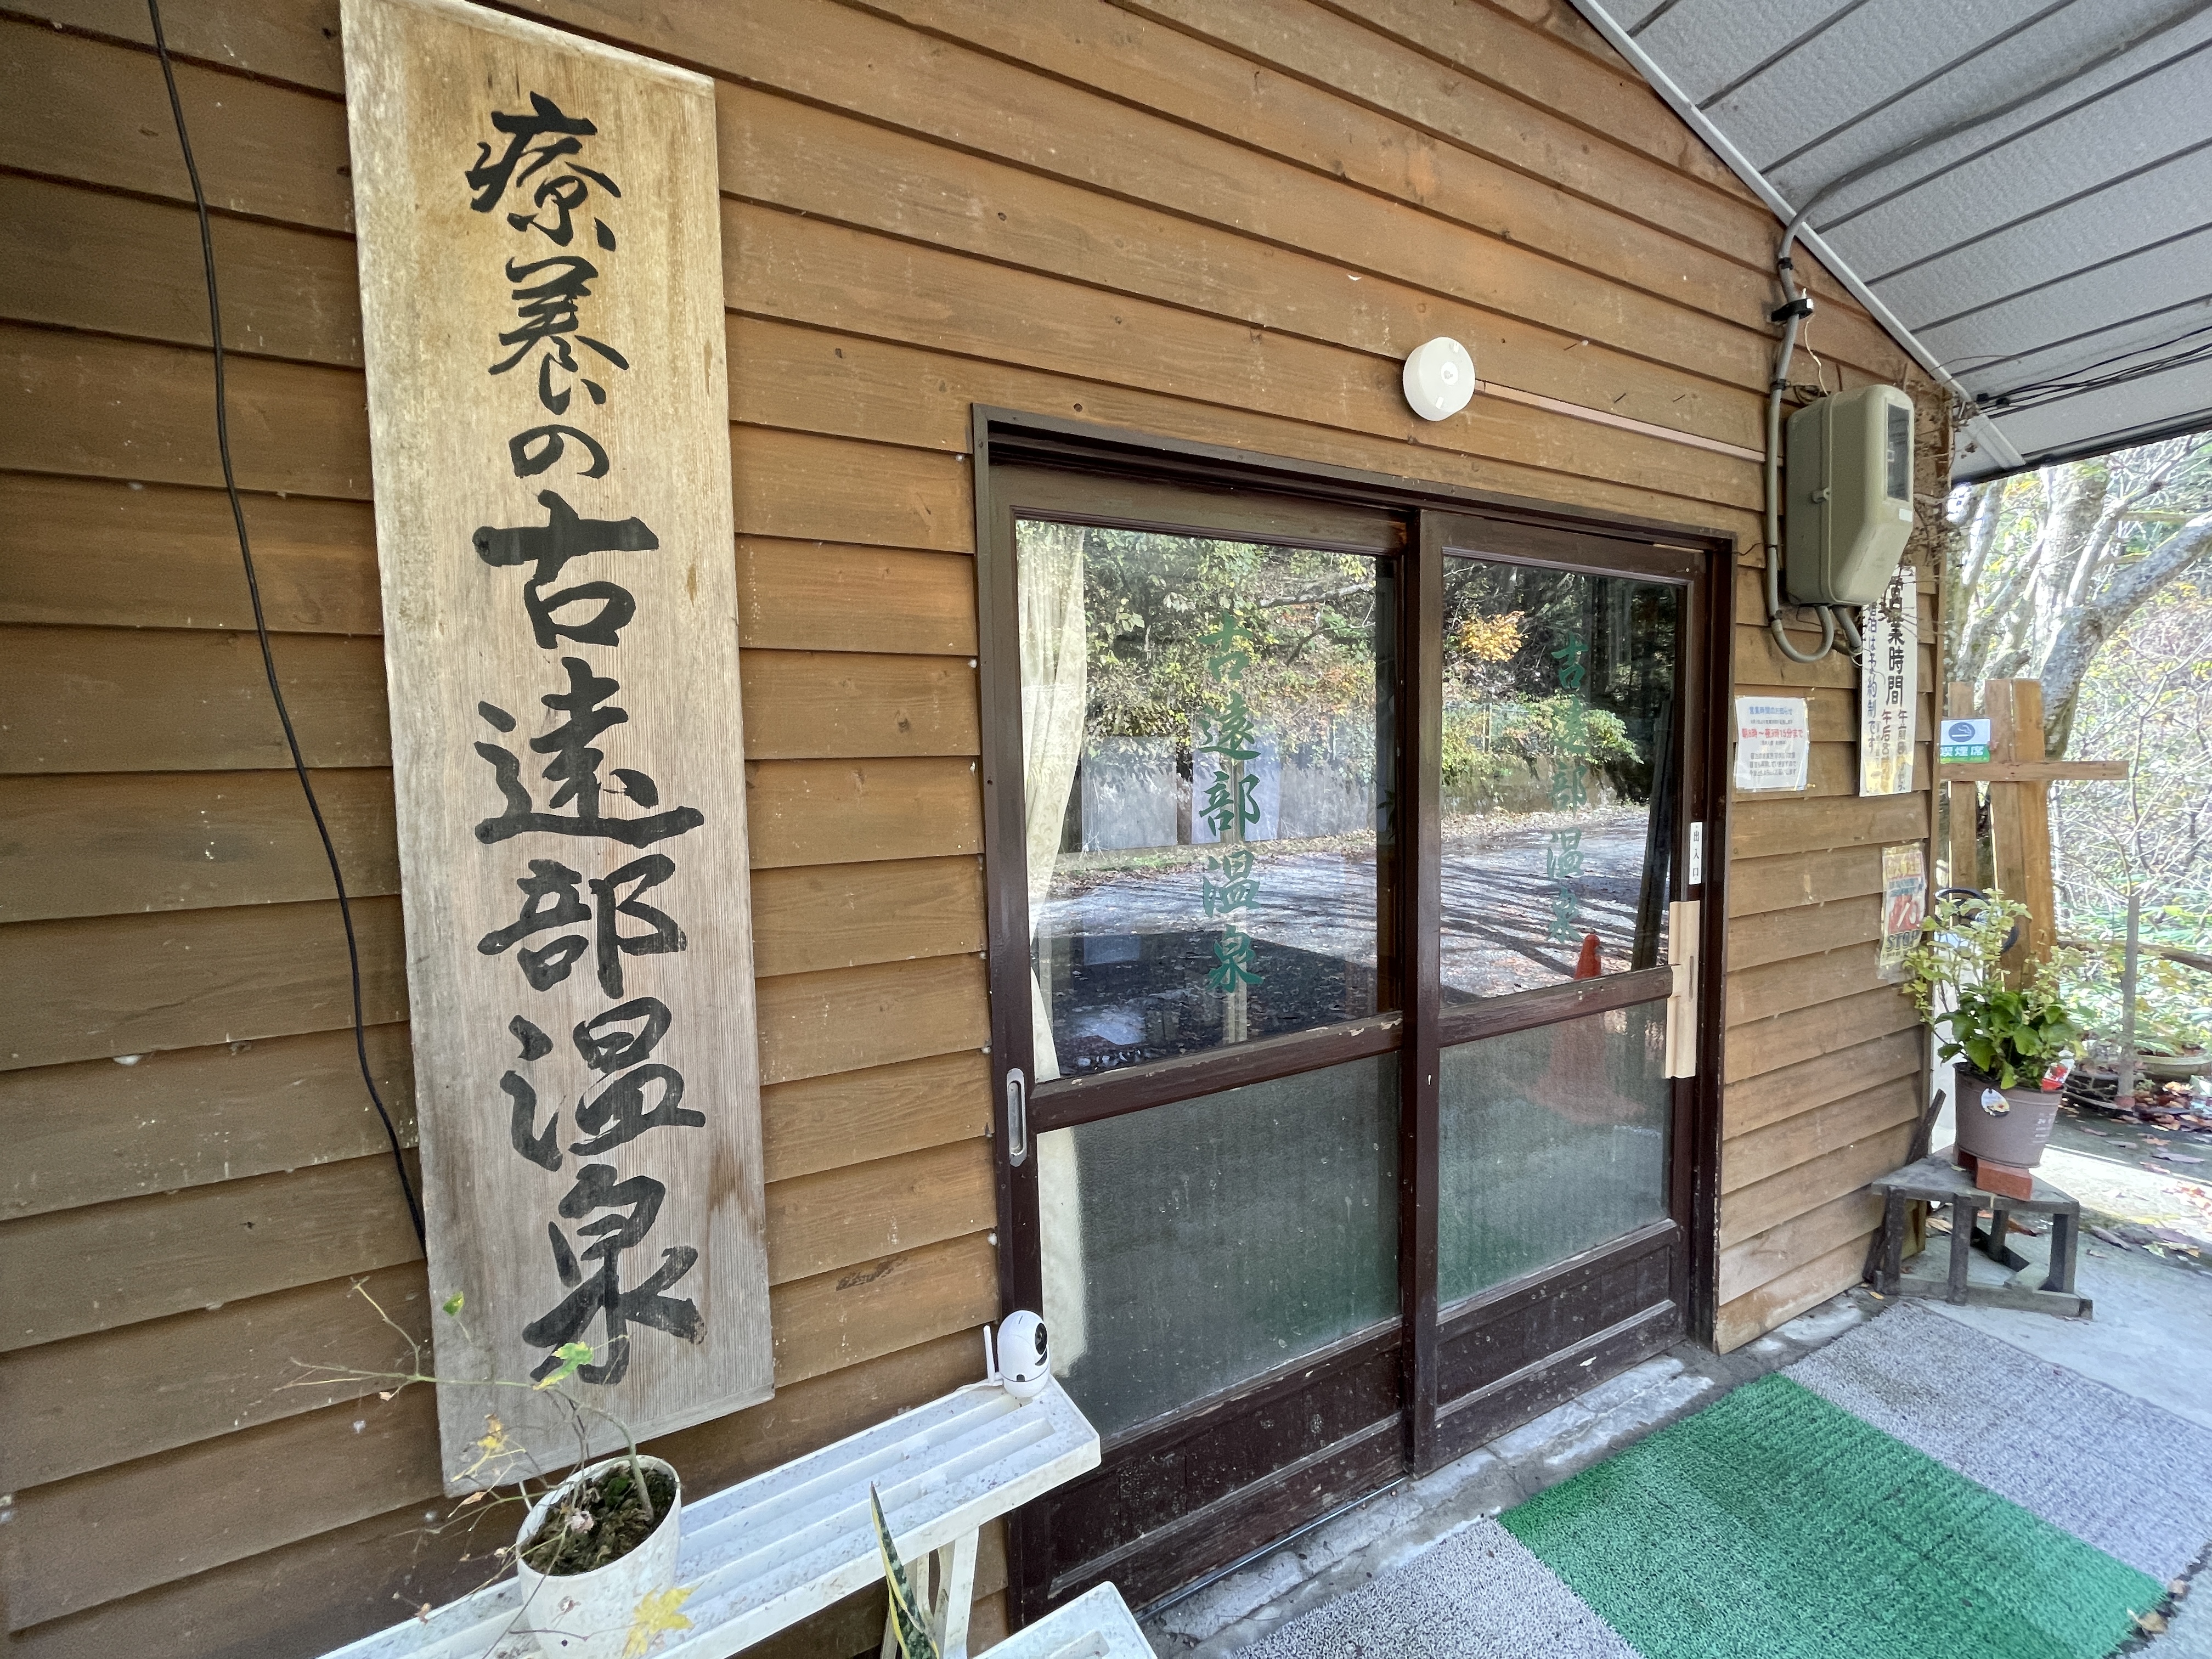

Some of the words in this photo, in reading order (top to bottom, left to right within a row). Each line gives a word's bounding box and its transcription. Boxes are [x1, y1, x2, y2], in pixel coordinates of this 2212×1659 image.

[1200, 610, 1262, 992] 古遠部温泉
[1547, 631, 1589, 944] 古遠部温泉
[1886, 929, 1920, 951] STOP
